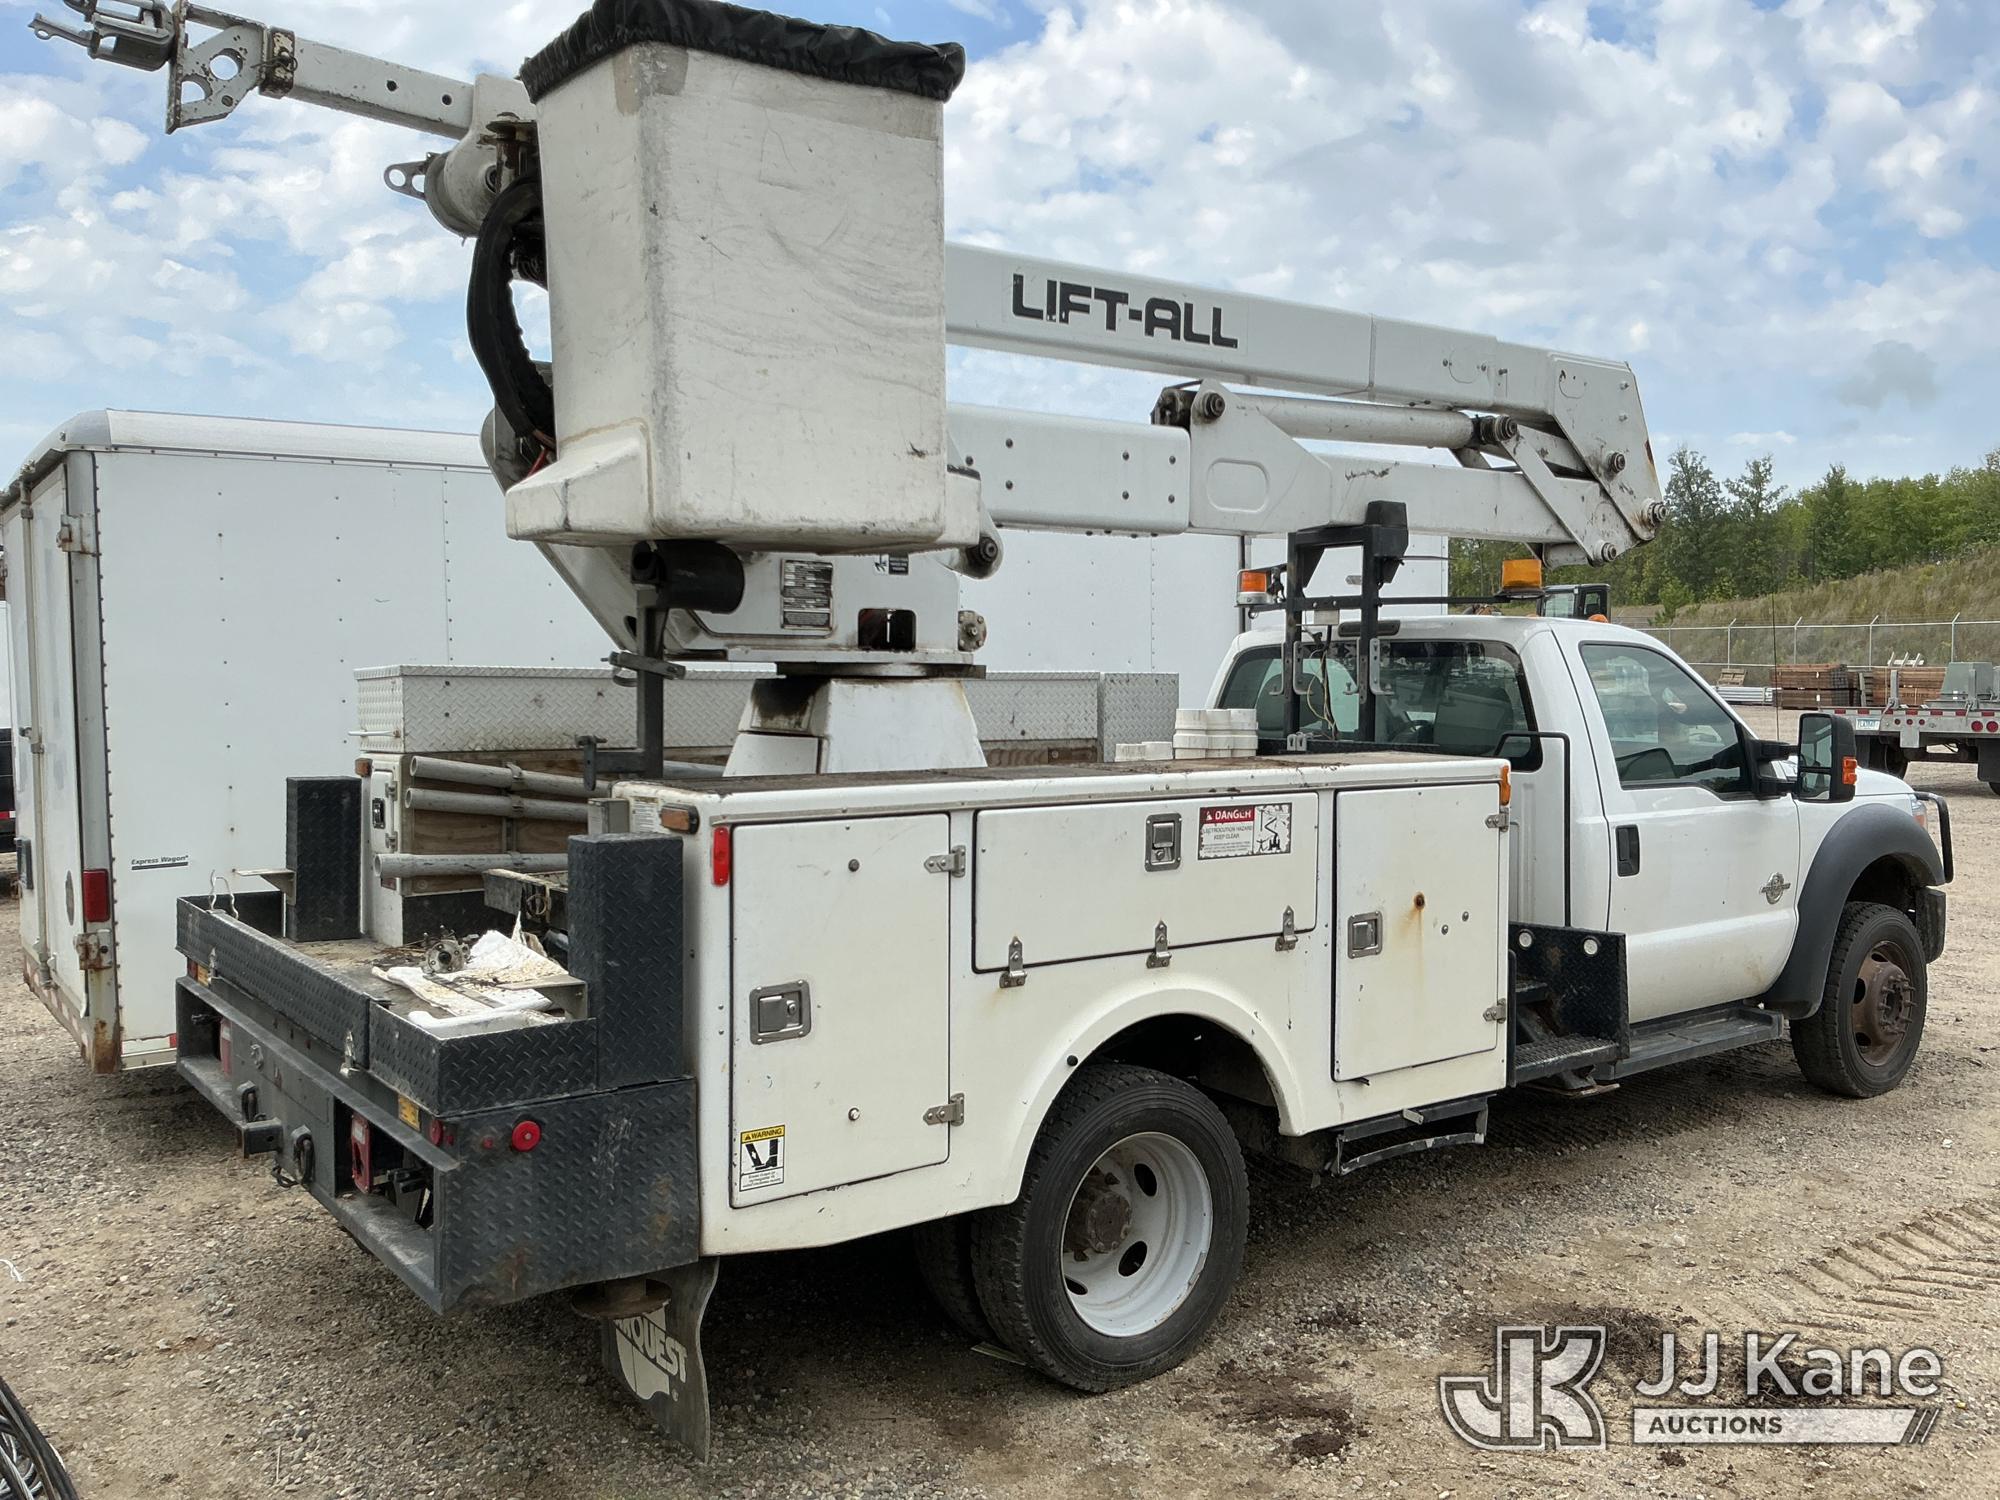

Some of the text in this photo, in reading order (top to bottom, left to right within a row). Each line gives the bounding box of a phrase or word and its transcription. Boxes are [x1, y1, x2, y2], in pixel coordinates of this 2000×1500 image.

[1012, 273, 1238, 349] LIFT-ALL
[131, 858, 159, 866] Express
[751, 1128, 783, 1139] WARNING
